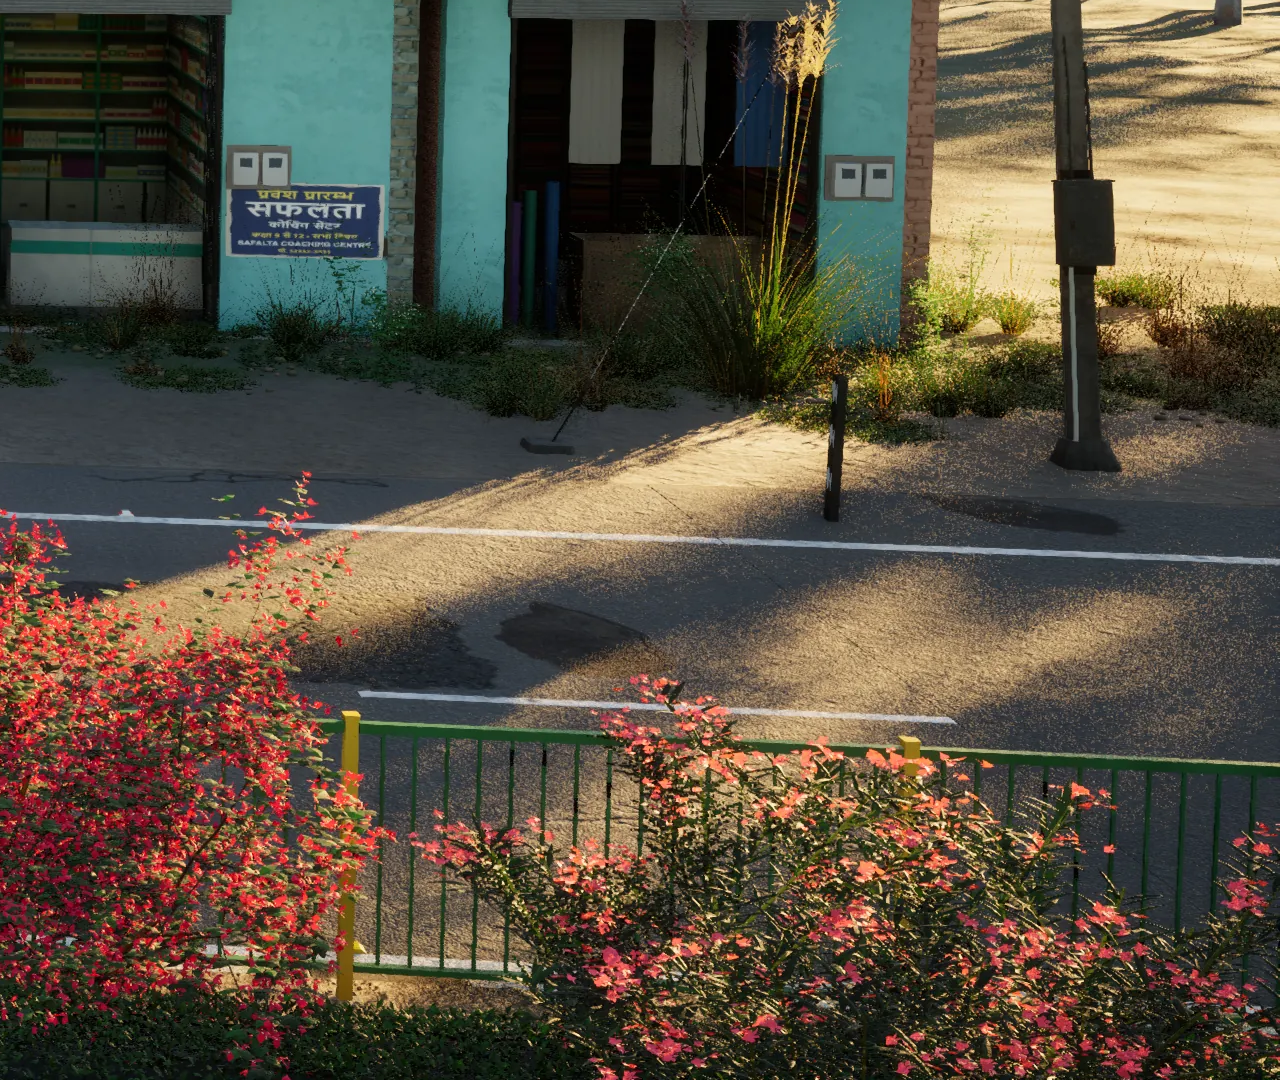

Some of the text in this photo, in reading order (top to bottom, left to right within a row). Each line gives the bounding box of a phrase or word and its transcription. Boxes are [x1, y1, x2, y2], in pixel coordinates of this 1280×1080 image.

[303, 190, 355, 202] प्रारम्भ
[244, 200, 367, 220] सफलता
[237, 239, 280, 247] SAFALTA
[280, 240, 331, 248] COACHING
